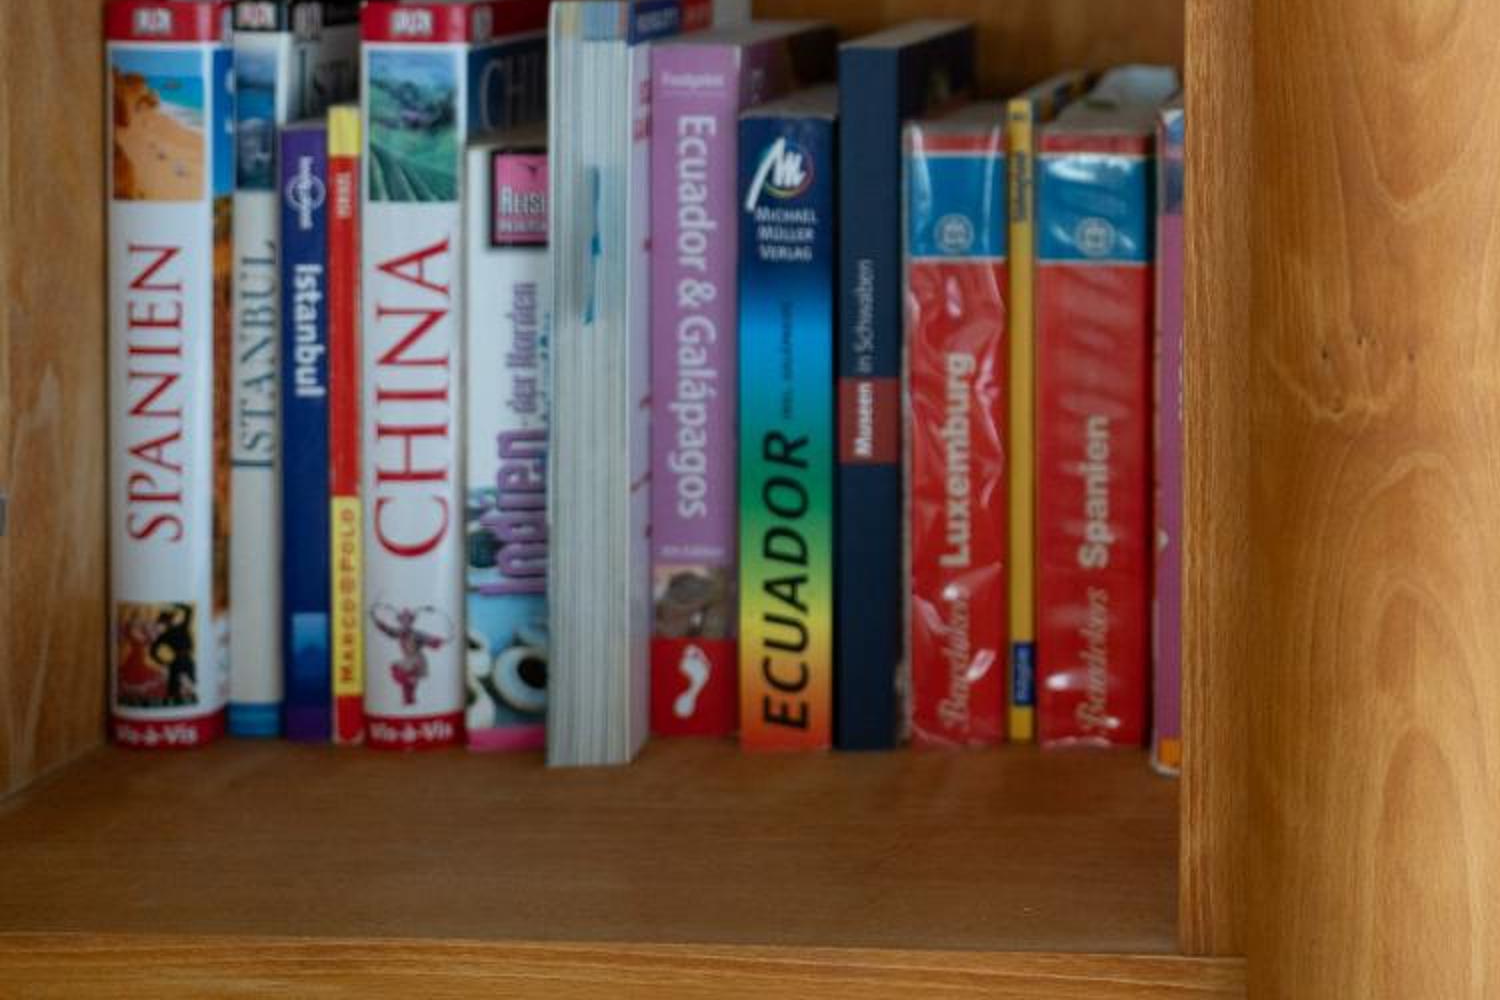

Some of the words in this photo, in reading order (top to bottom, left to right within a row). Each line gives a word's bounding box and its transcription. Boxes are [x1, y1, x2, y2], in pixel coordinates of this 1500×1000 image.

[678, 115, 717, 270] Ecuador
[678, 278, 717, 307] &
[127, 243, 183, 543] SPANIEN
[231, 240, 277, 468] ISTANBUL
[294, 264, 325, 397] Istanbul
[373, 236, 450, 557] CHINA
[668, 316, 717, 517] Galápagos
[855, 382, 873, 457] Museen
[940, 353, 975, 567] Luxemburg
[1078, 415, 1114, 568] Spanien
[762, 430, 811, 728] ECUADOR
